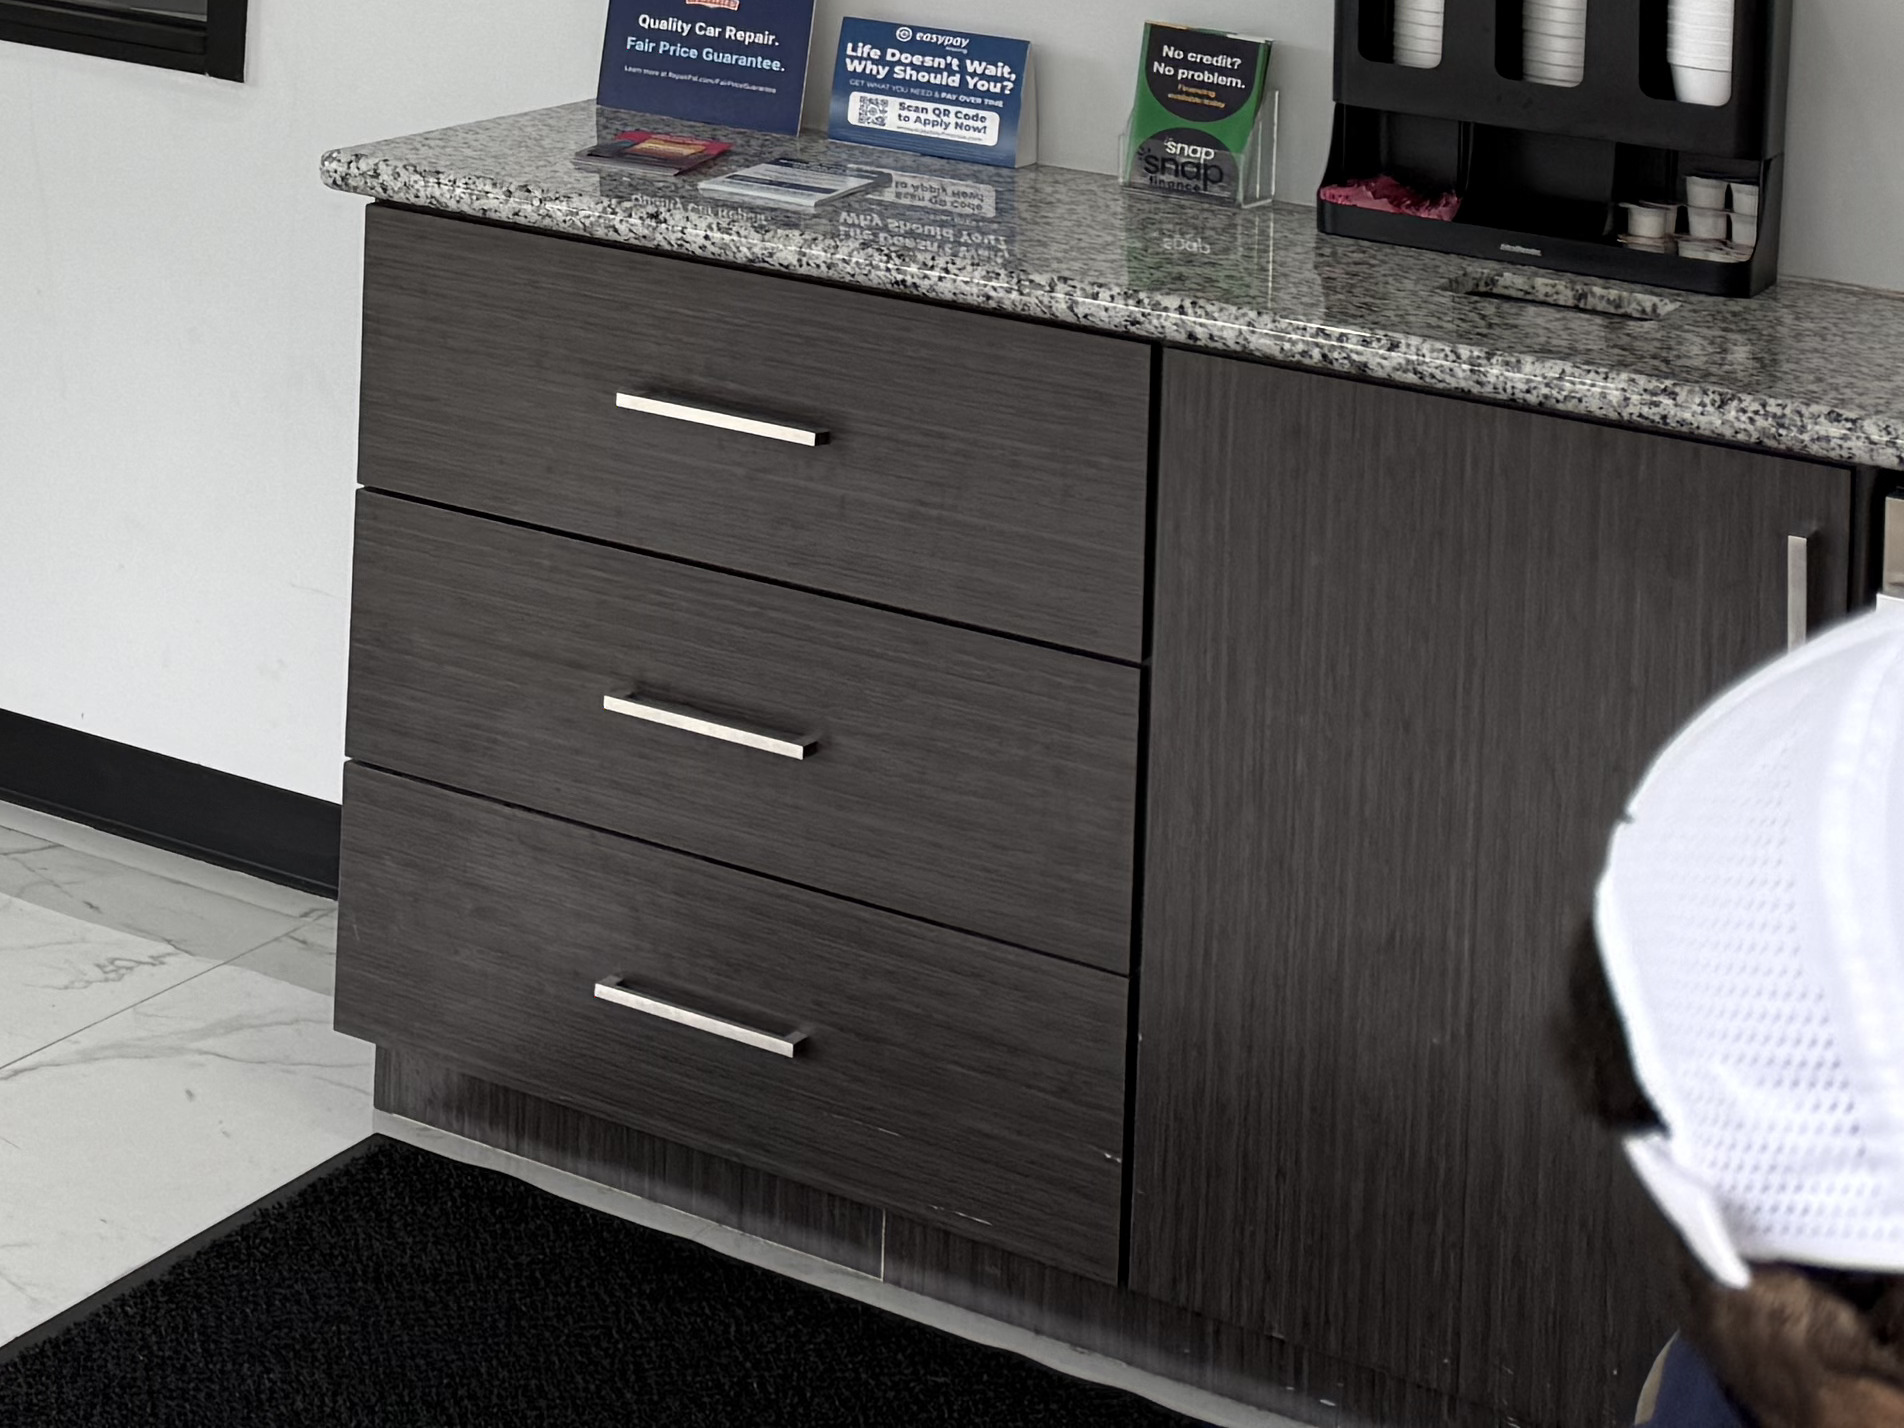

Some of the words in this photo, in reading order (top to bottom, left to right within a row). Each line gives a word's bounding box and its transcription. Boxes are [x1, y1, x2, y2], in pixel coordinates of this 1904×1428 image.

[638, 14, 691, 37] Quality
[695, 22, 722, 38] Car
[725, 26, 780, 46] Repair.
[916, 32, 970, 48] easypay
[626, 36, 656, 53] Fair
[658, 41, 698, 59] Price
[702, 48, 786, 72] Guarantee.
[846, 42, 882, 59] Life
[886, 48, 960, 71] Doesn't
[965, 59, 1017, 81] Wait,
[1162, 45, 1184, 60] No
[1187, 51, 1242, 70] credit?
[845, 58, 890, 80] Why
[894, 66, 961, 87] Should
[965, 75, 1014, 94] You?
[1153, 61, 1175, 76] No
[1177, 67, 1245, 89] problem.
[849, 78, 865, 87] GET
[867, 81, 890, 91] WHAT
[892, 85, 909, 94] YOU
[910, 87, 933, 97] NEED
[941, 91, 957, 101] PAY
[958, 94, 983, 105] OVER
[984, 98, 1004, 108] TIME
[898, 113, 910, 123] to
[913, 117, 951, 130] Apply
[954, 121, 987, 134] Now!
[899, 101, 929, 115] Scan
[932, 107, 951, 119] QR
[954, 110, 987, 124] Code
[1165, 139, 1215, 163] snap
[1144, 154, 1223, 191] snap
[1149, 175, 1201, 193] finance
